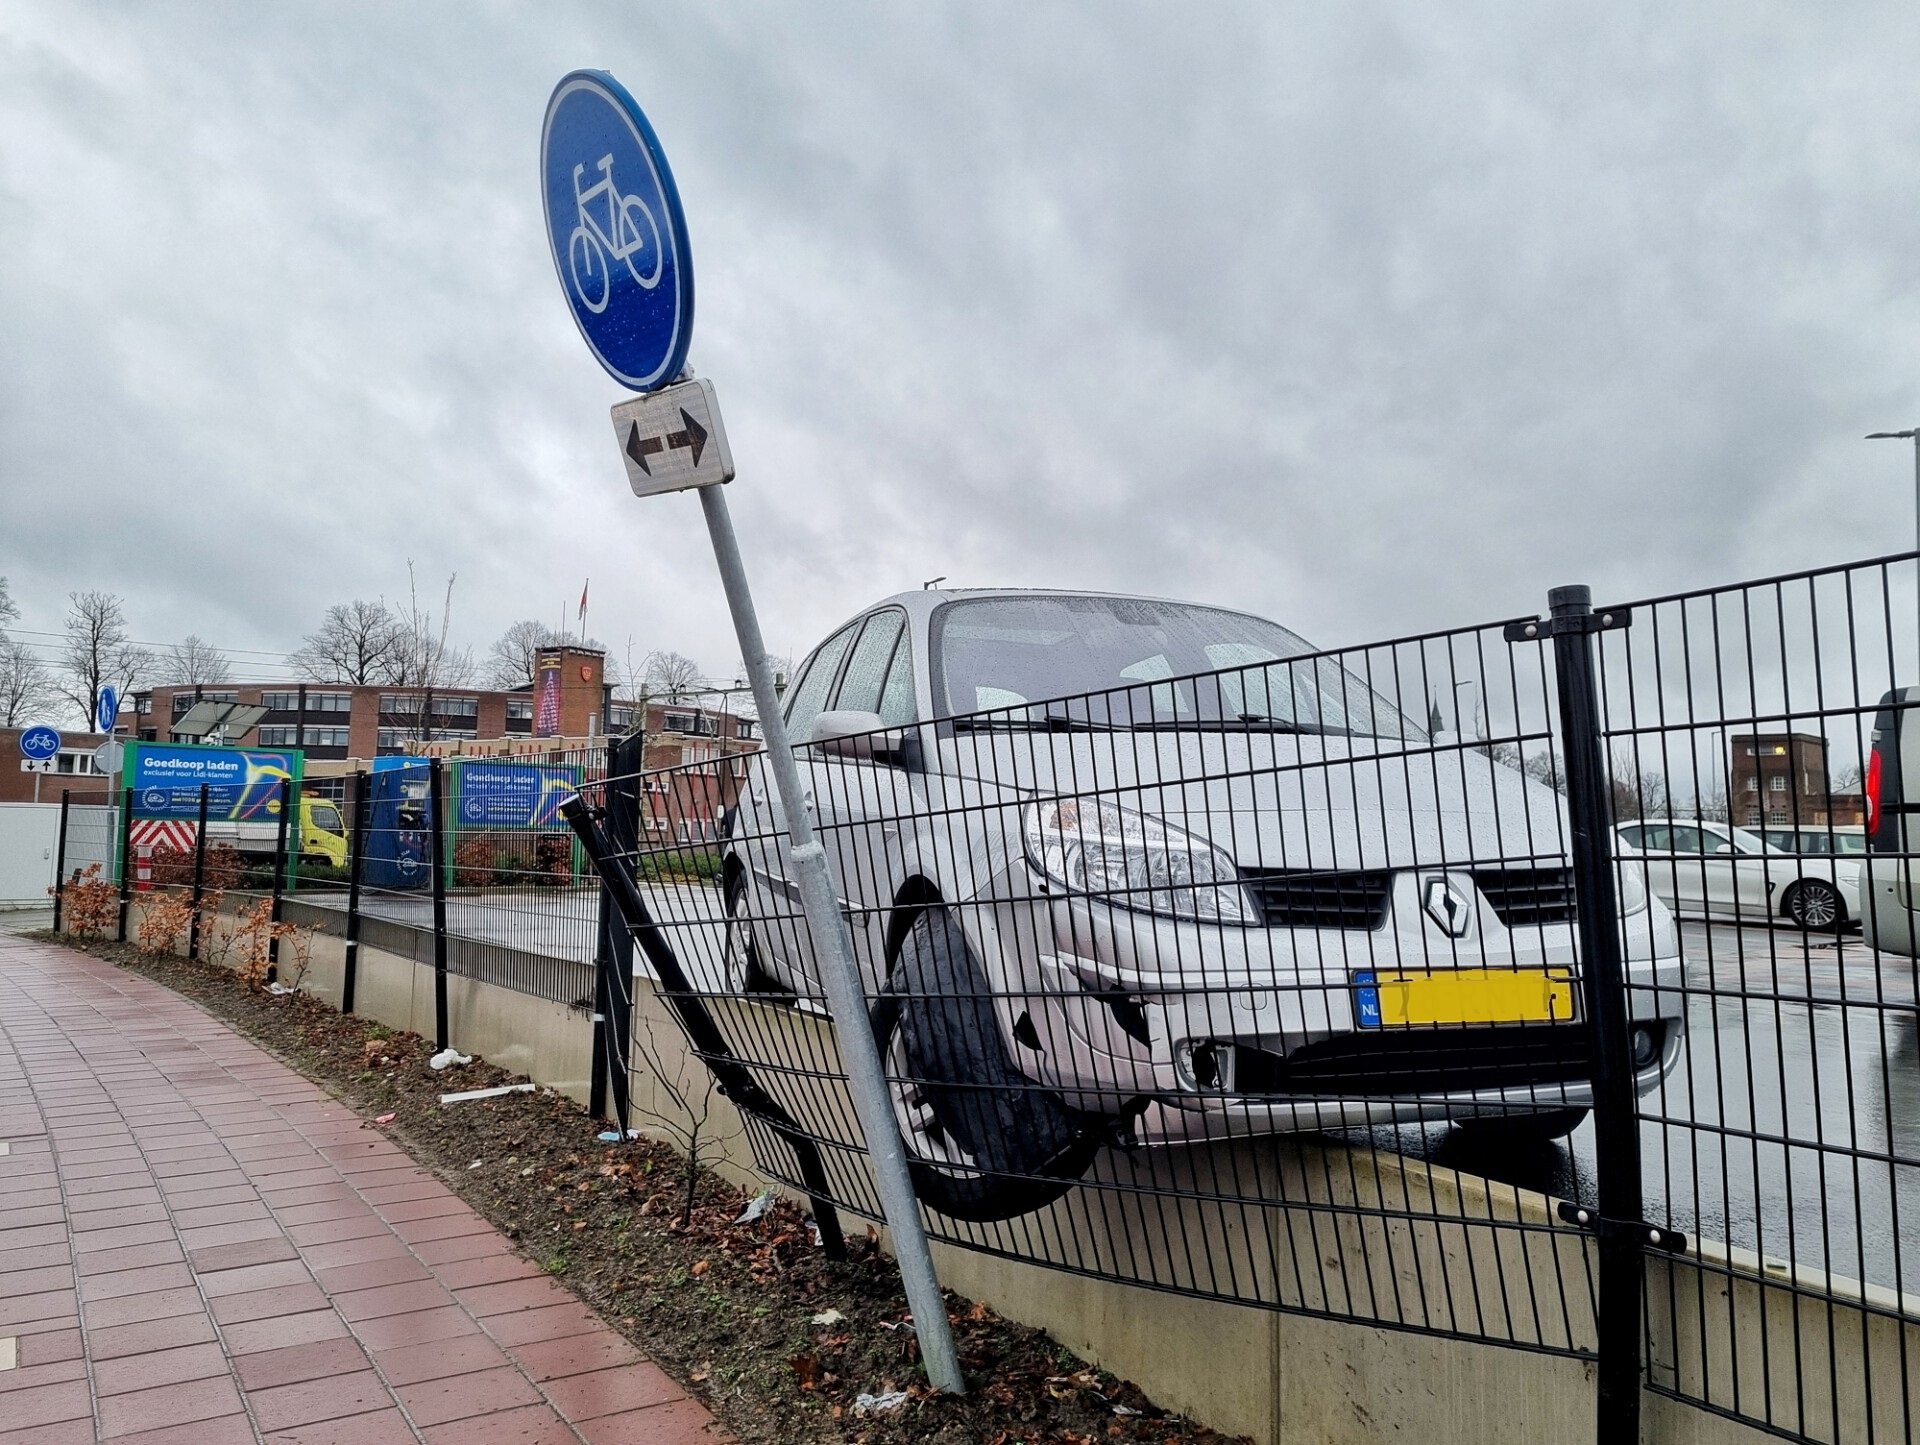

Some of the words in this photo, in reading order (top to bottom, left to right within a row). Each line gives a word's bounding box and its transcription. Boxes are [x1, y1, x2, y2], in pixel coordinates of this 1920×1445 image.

[144, 758, 204, 770] Goedkoop
[207, 760, 239, 770] laden
[1361, 1004, 1379, 1016] NL
